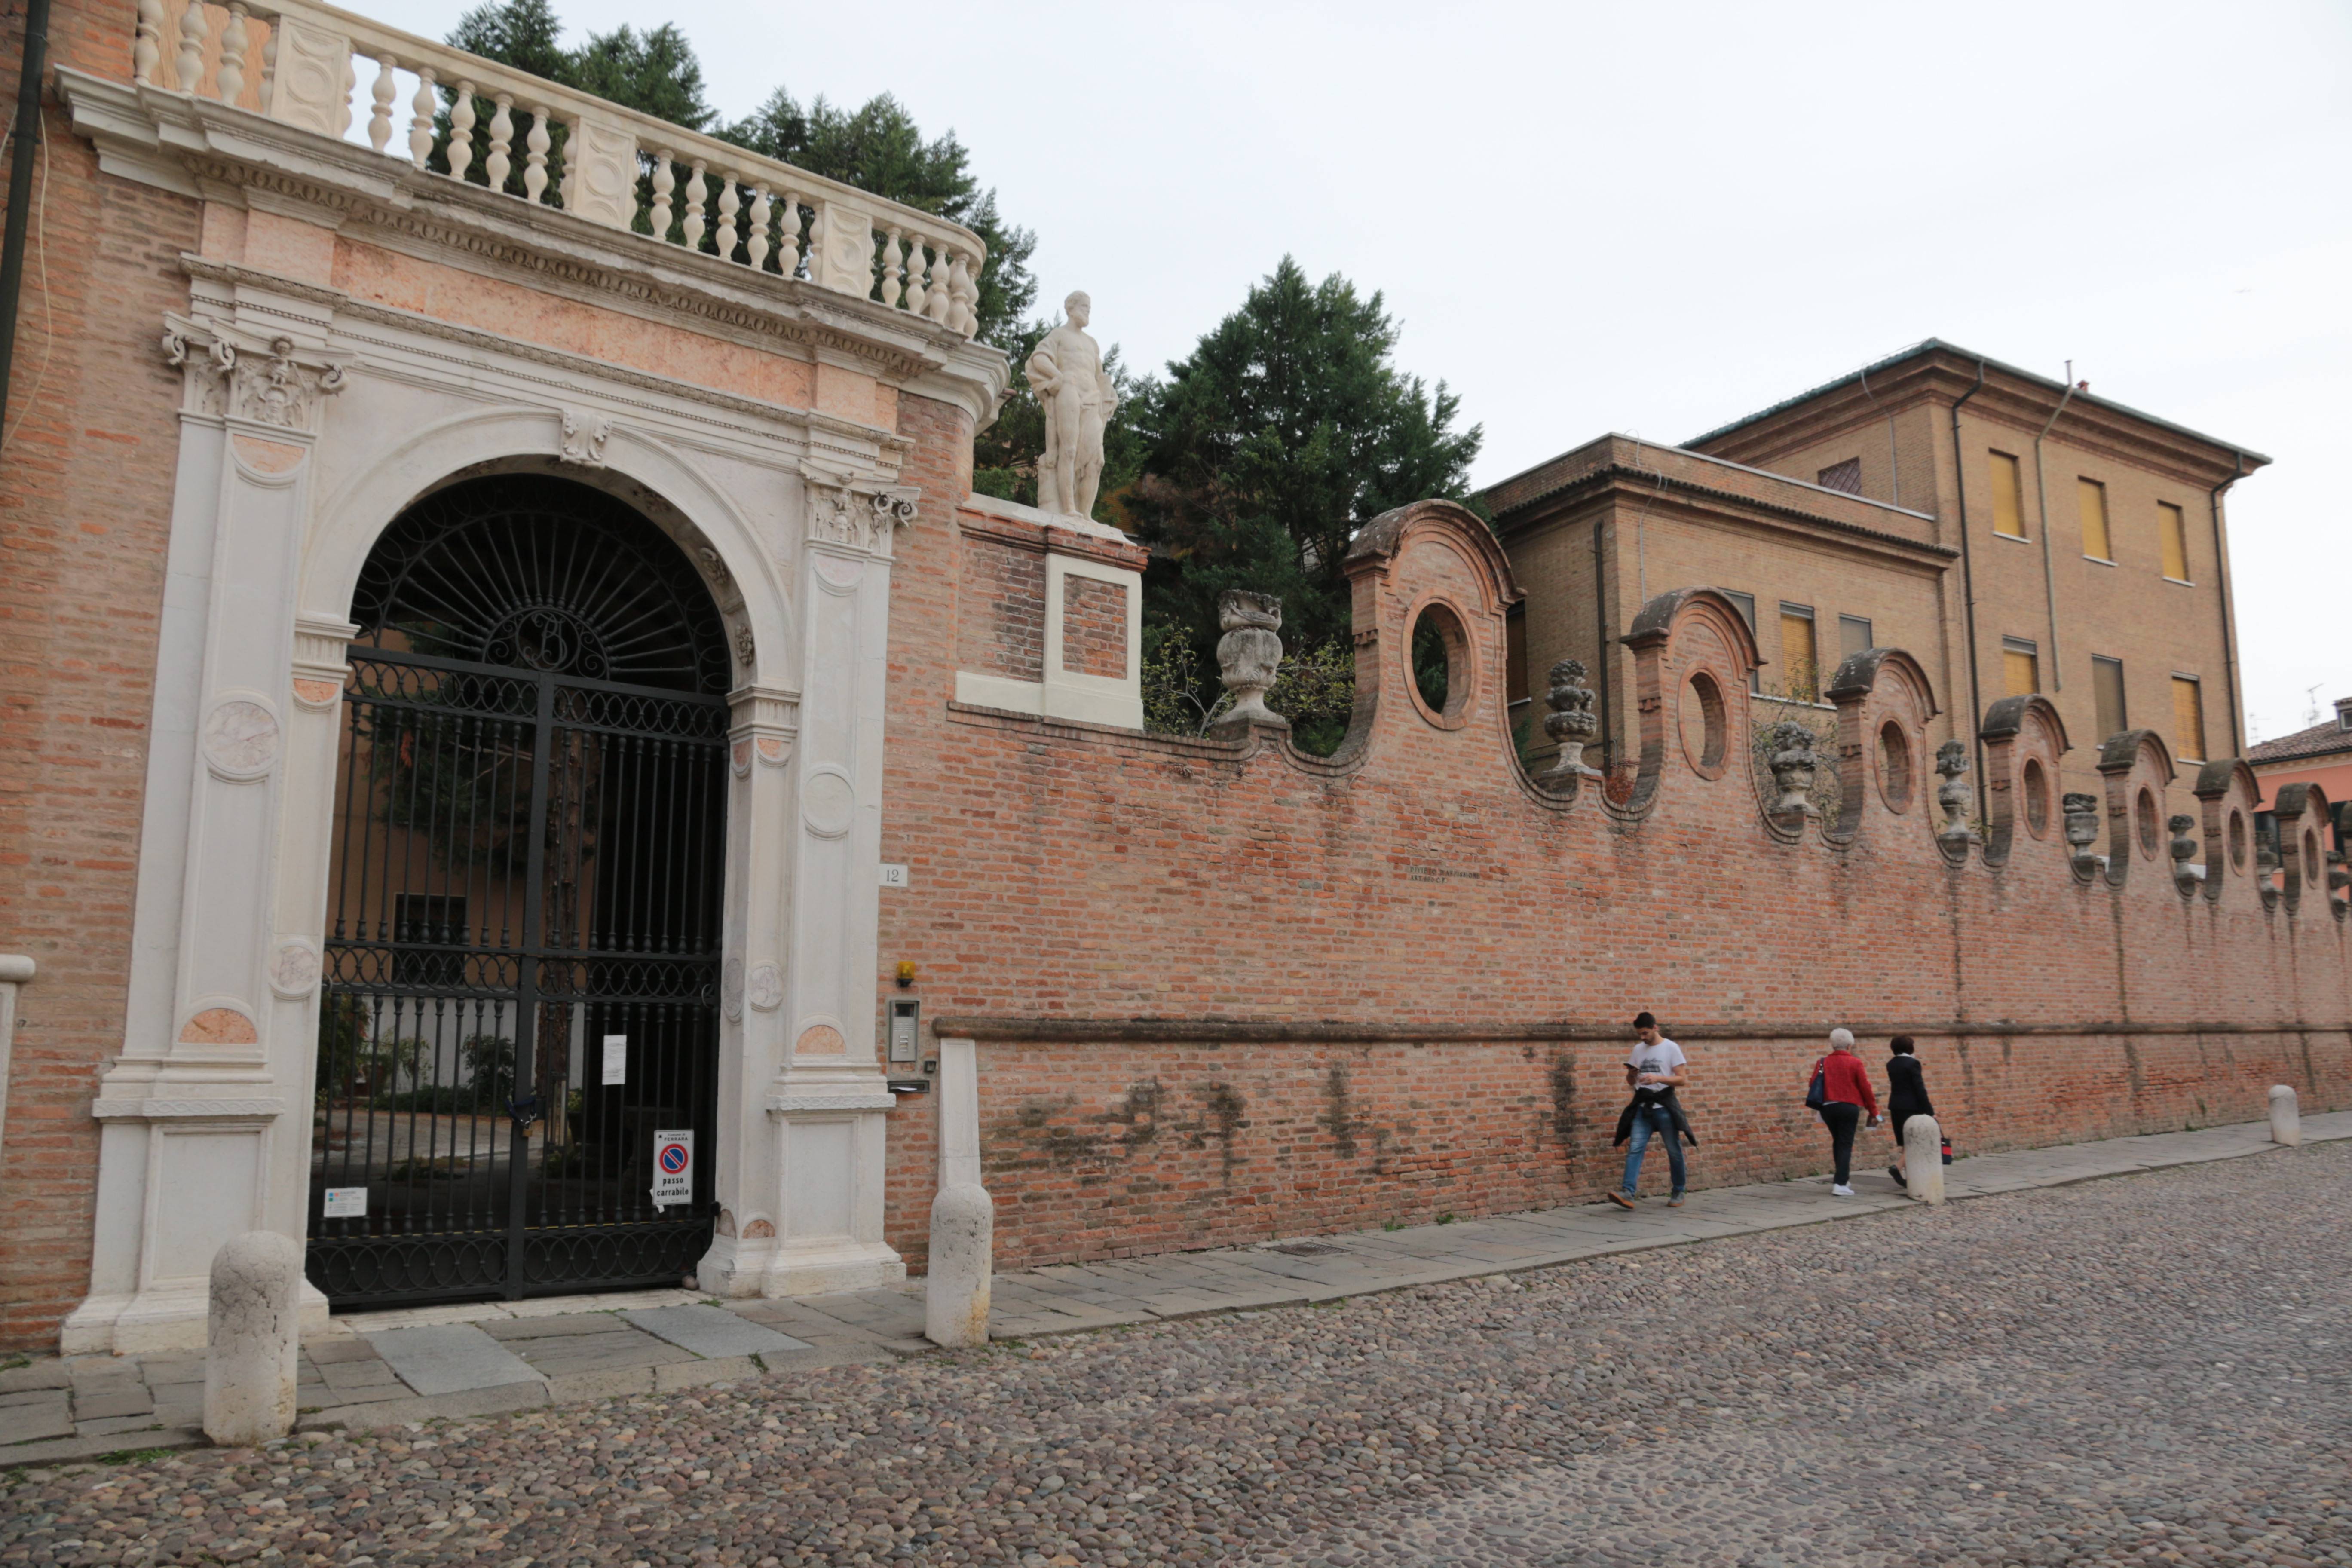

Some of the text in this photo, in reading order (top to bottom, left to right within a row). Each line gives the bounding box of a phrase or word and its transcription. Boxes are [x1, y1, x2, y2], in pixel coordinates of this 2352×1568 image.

[887, 869, 898, 882] 12
[663, 1178, 683, 1187] passo
[657, 1187, 689, 1197] carrabile
